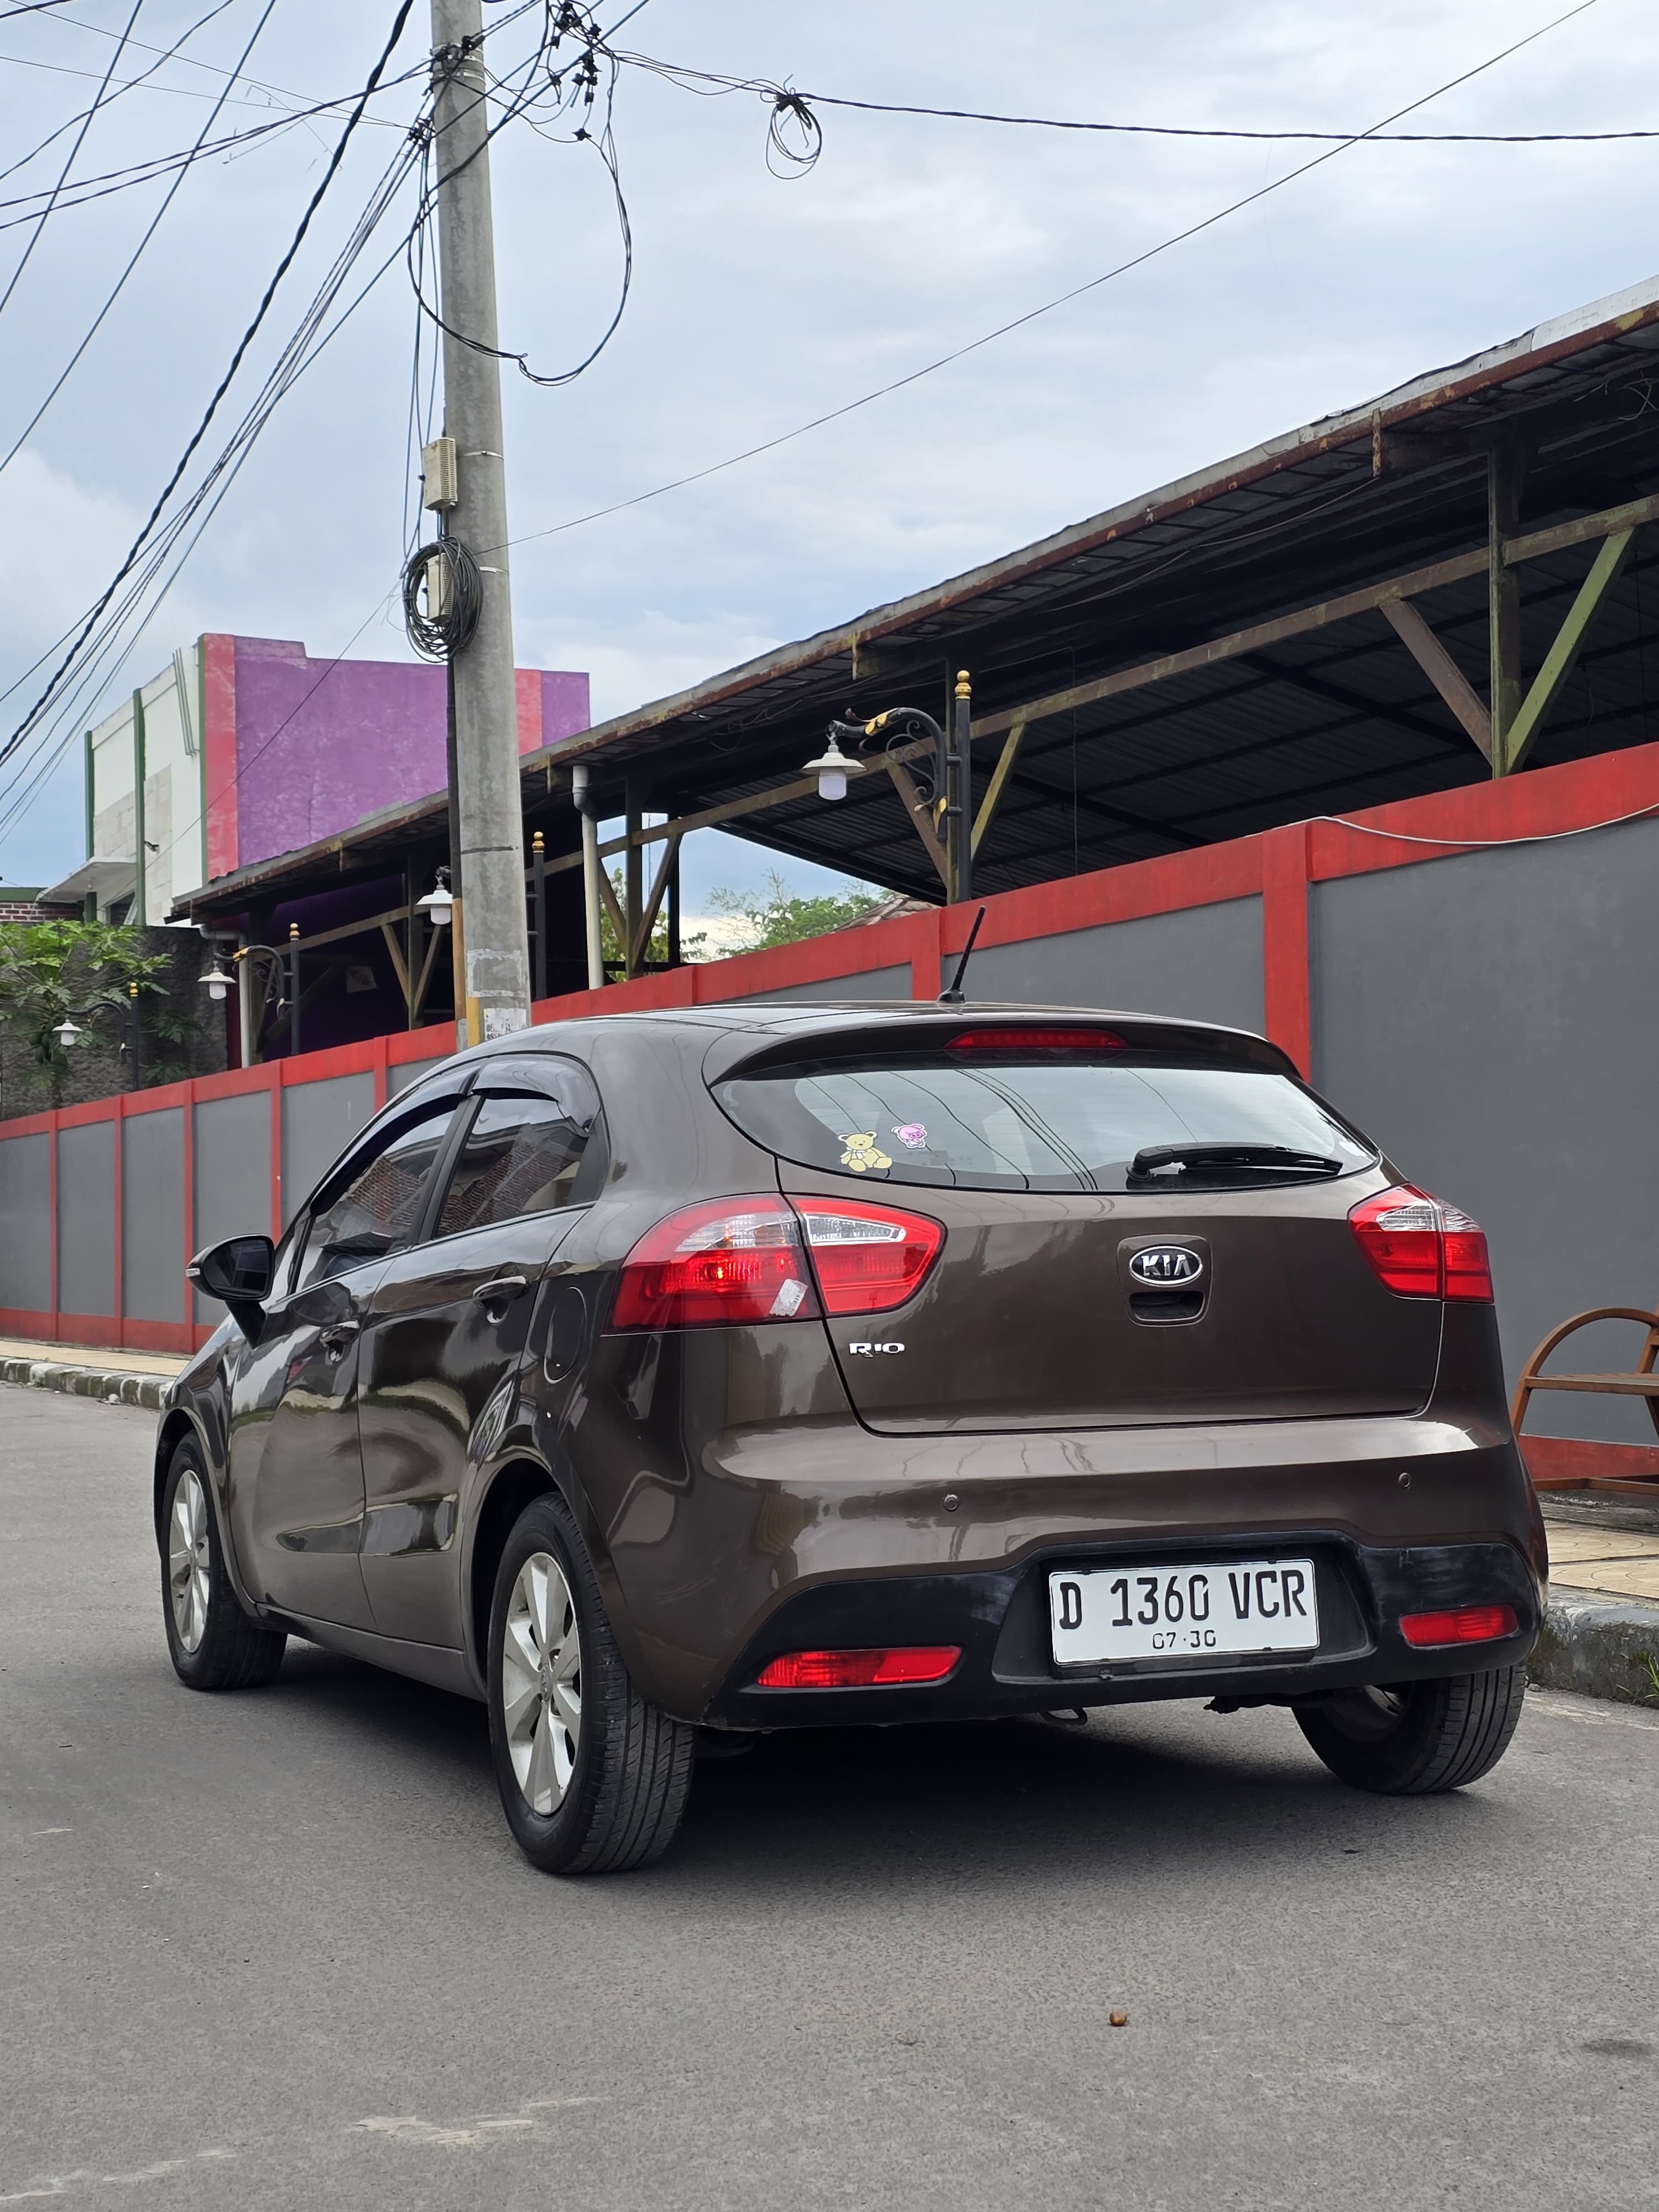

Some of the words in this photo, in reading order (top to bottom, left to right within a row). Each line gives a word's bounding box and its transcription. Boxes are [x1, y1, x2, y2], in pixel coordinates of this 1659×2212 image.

[1141, 1255, 1191, 1276] KIA
[849, 1343, 905, 1358] RIO
[1059, 1582, 1082, 1630] D
[1110, 1574, 1210, 1627] 1360
[1228, 1569, 1307, 1620] VCR
